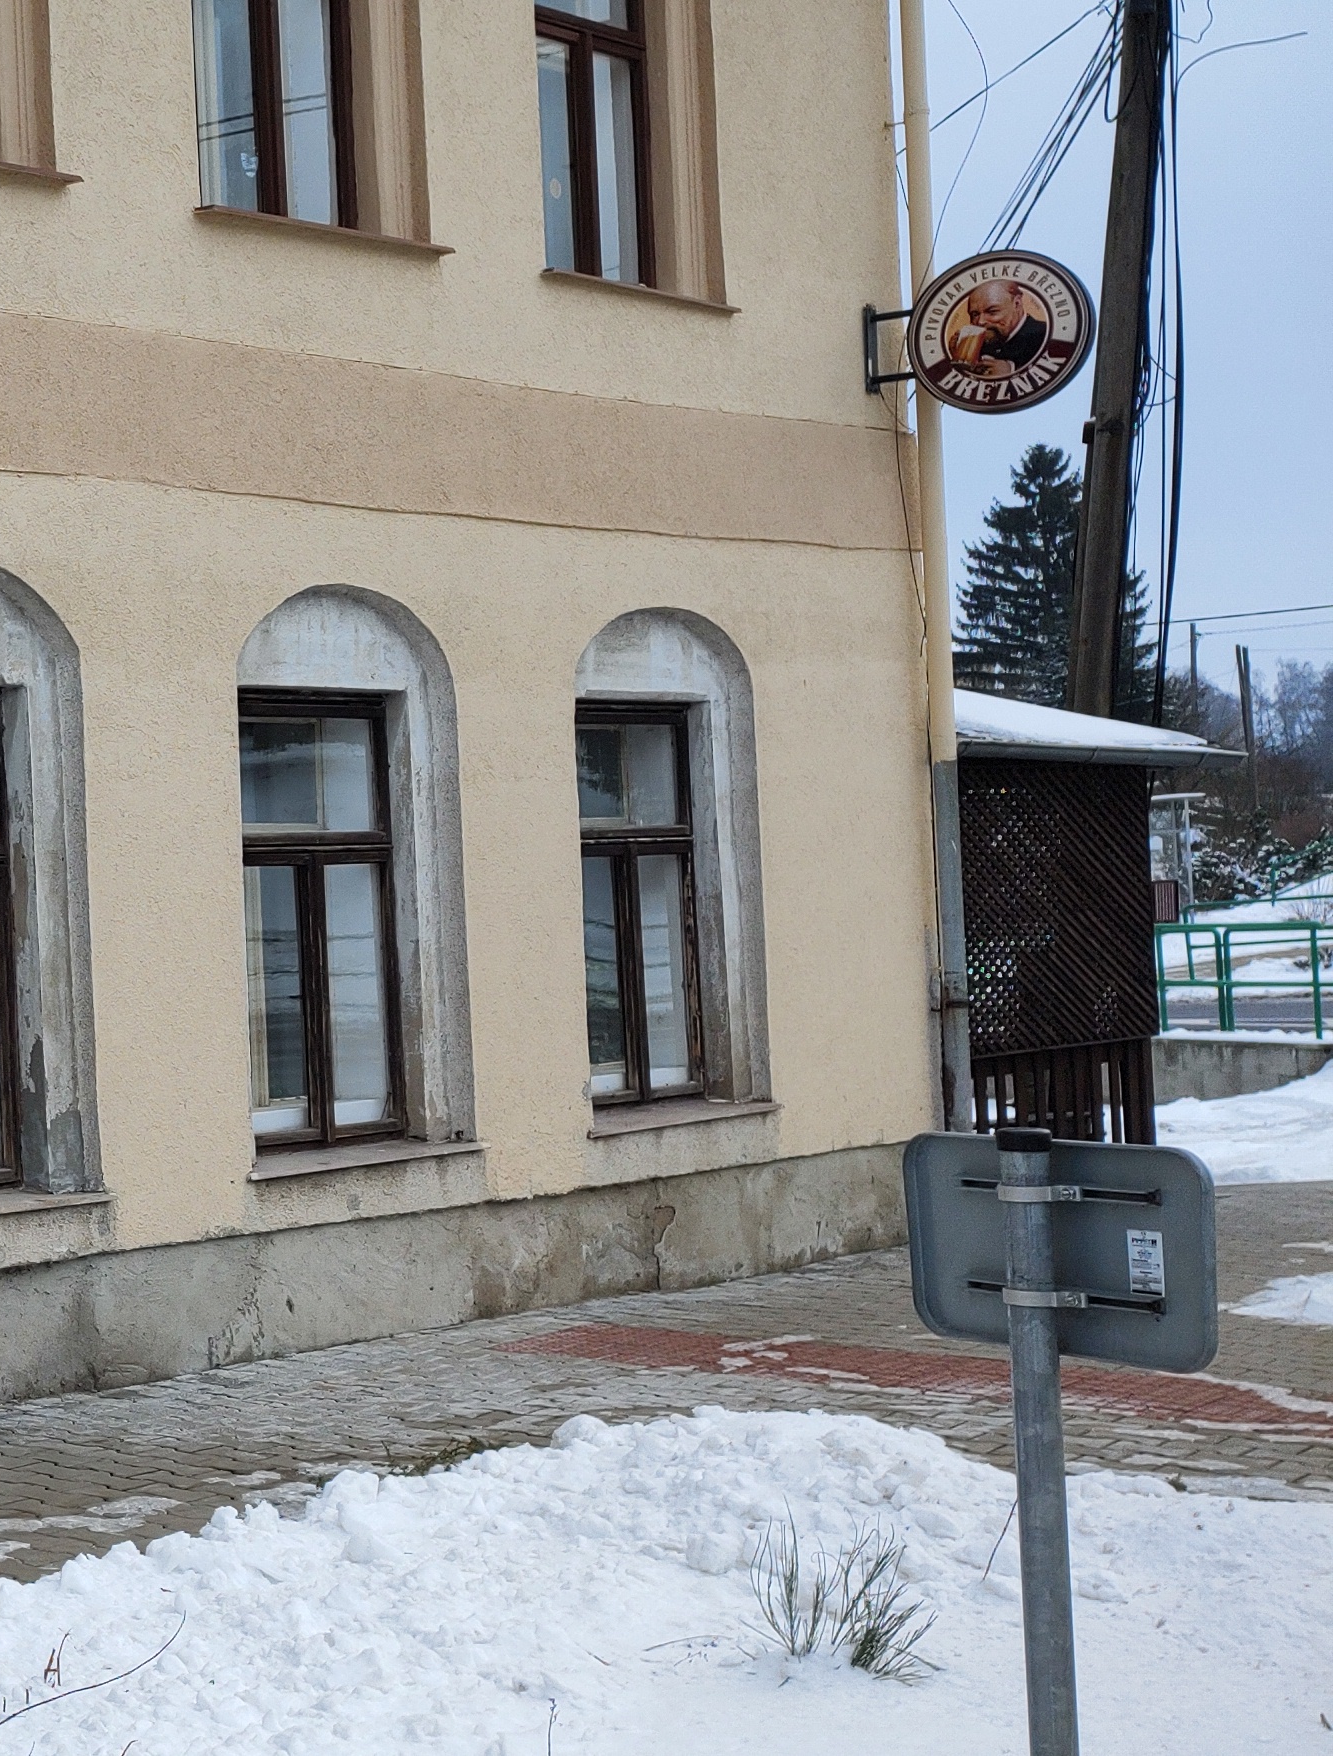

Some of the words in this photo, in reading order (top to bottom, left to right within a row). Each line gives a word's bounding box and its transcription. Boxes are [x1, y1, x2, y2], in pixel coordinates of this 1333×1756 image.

[925, 282, 965, 341] PIVOVAR
[970, 264, 1021, 283] VELKÉ
[1027, 270, 1071, 319] BŘEZNO
[937, 350, 1067, 403] BŘEZŇÁK
